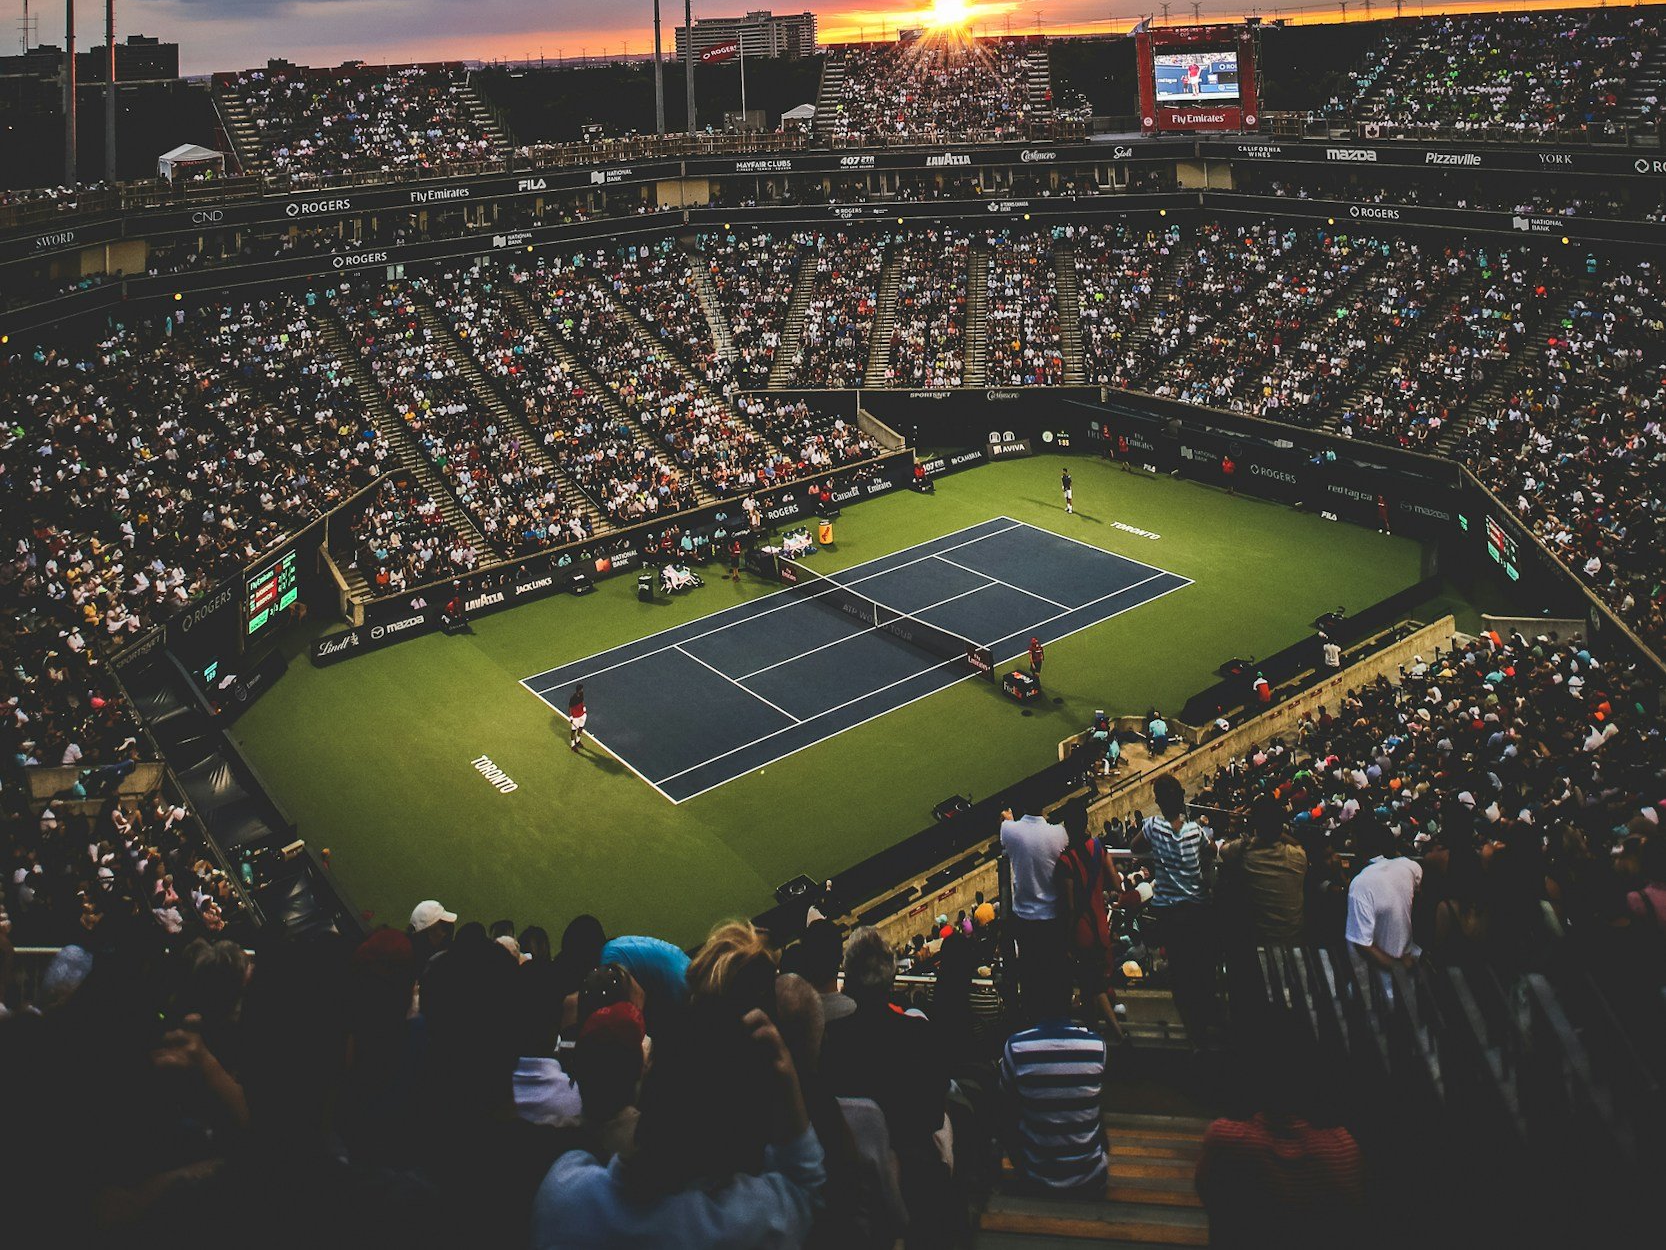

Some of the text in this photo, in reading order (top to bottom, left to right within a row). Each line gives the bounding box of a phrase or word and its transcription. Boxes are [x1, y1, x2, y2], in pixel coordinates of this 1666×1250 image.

[1172, 114, 1224, 125] Fly Emirates
[1113, 146, 1132, 159] Stoli
[1237, 145, 1281, 153] CALIFORNIA
[736, 161, 767, 169] MAYFAIR
[840, 156, 860, 165] 407
[926, 153, 971, 166] LAVAZZA
[1425, 152, 1481, 165] Pizzaville
[1539, 153, 1572, 164] YORK
[606, 169, 632, 177] NATIONAL
[518, 178, 547, 191] FILA
[410, 188, 470, 202] Fly Emirates
[301, 199, 350, 214] ROGERS
[192, 210, 224, 223] CND
[1361, 208, 1399, 219] ROGERS
[1531, 219, 1563, 227] NATIONAL
[36, 232, 74, 248] SWORD
[507, 232, 532, 240] NATIONAL
[346, 252, 387, 265] ROGERS
[1002, 444, 1025, 453] AVIVA
[957, 451, 982, 463] CAMBRIA
[1143, 463, 1156, 473] FILA
[873, 477, 882, 485] Fly
[1261, 467, 1297, 484] ROGERS
[831, 486, 860, 502] Canada
[867, 481, 892, 494] Emirates
[767, 504, 799, 520] ROGERS
[1321, 510, 1338, 521] FILA
[1110, 521, 1161, 540] TORONTO
[611, 550, 638, 562] NATIONAL
[612, 558, 629, 568] BANK
[515, 583, 532, 595] JACK
[194, 588, 231, 623] ROGERS
[465, 592, 504, 611] LAVAZZA
[842, 603, 858, 615] ATP
[890, 624, 913, 641] TOUR
[316, 634, 350, 657] Lindt
[470, 754, 519, 794] TORONTO
